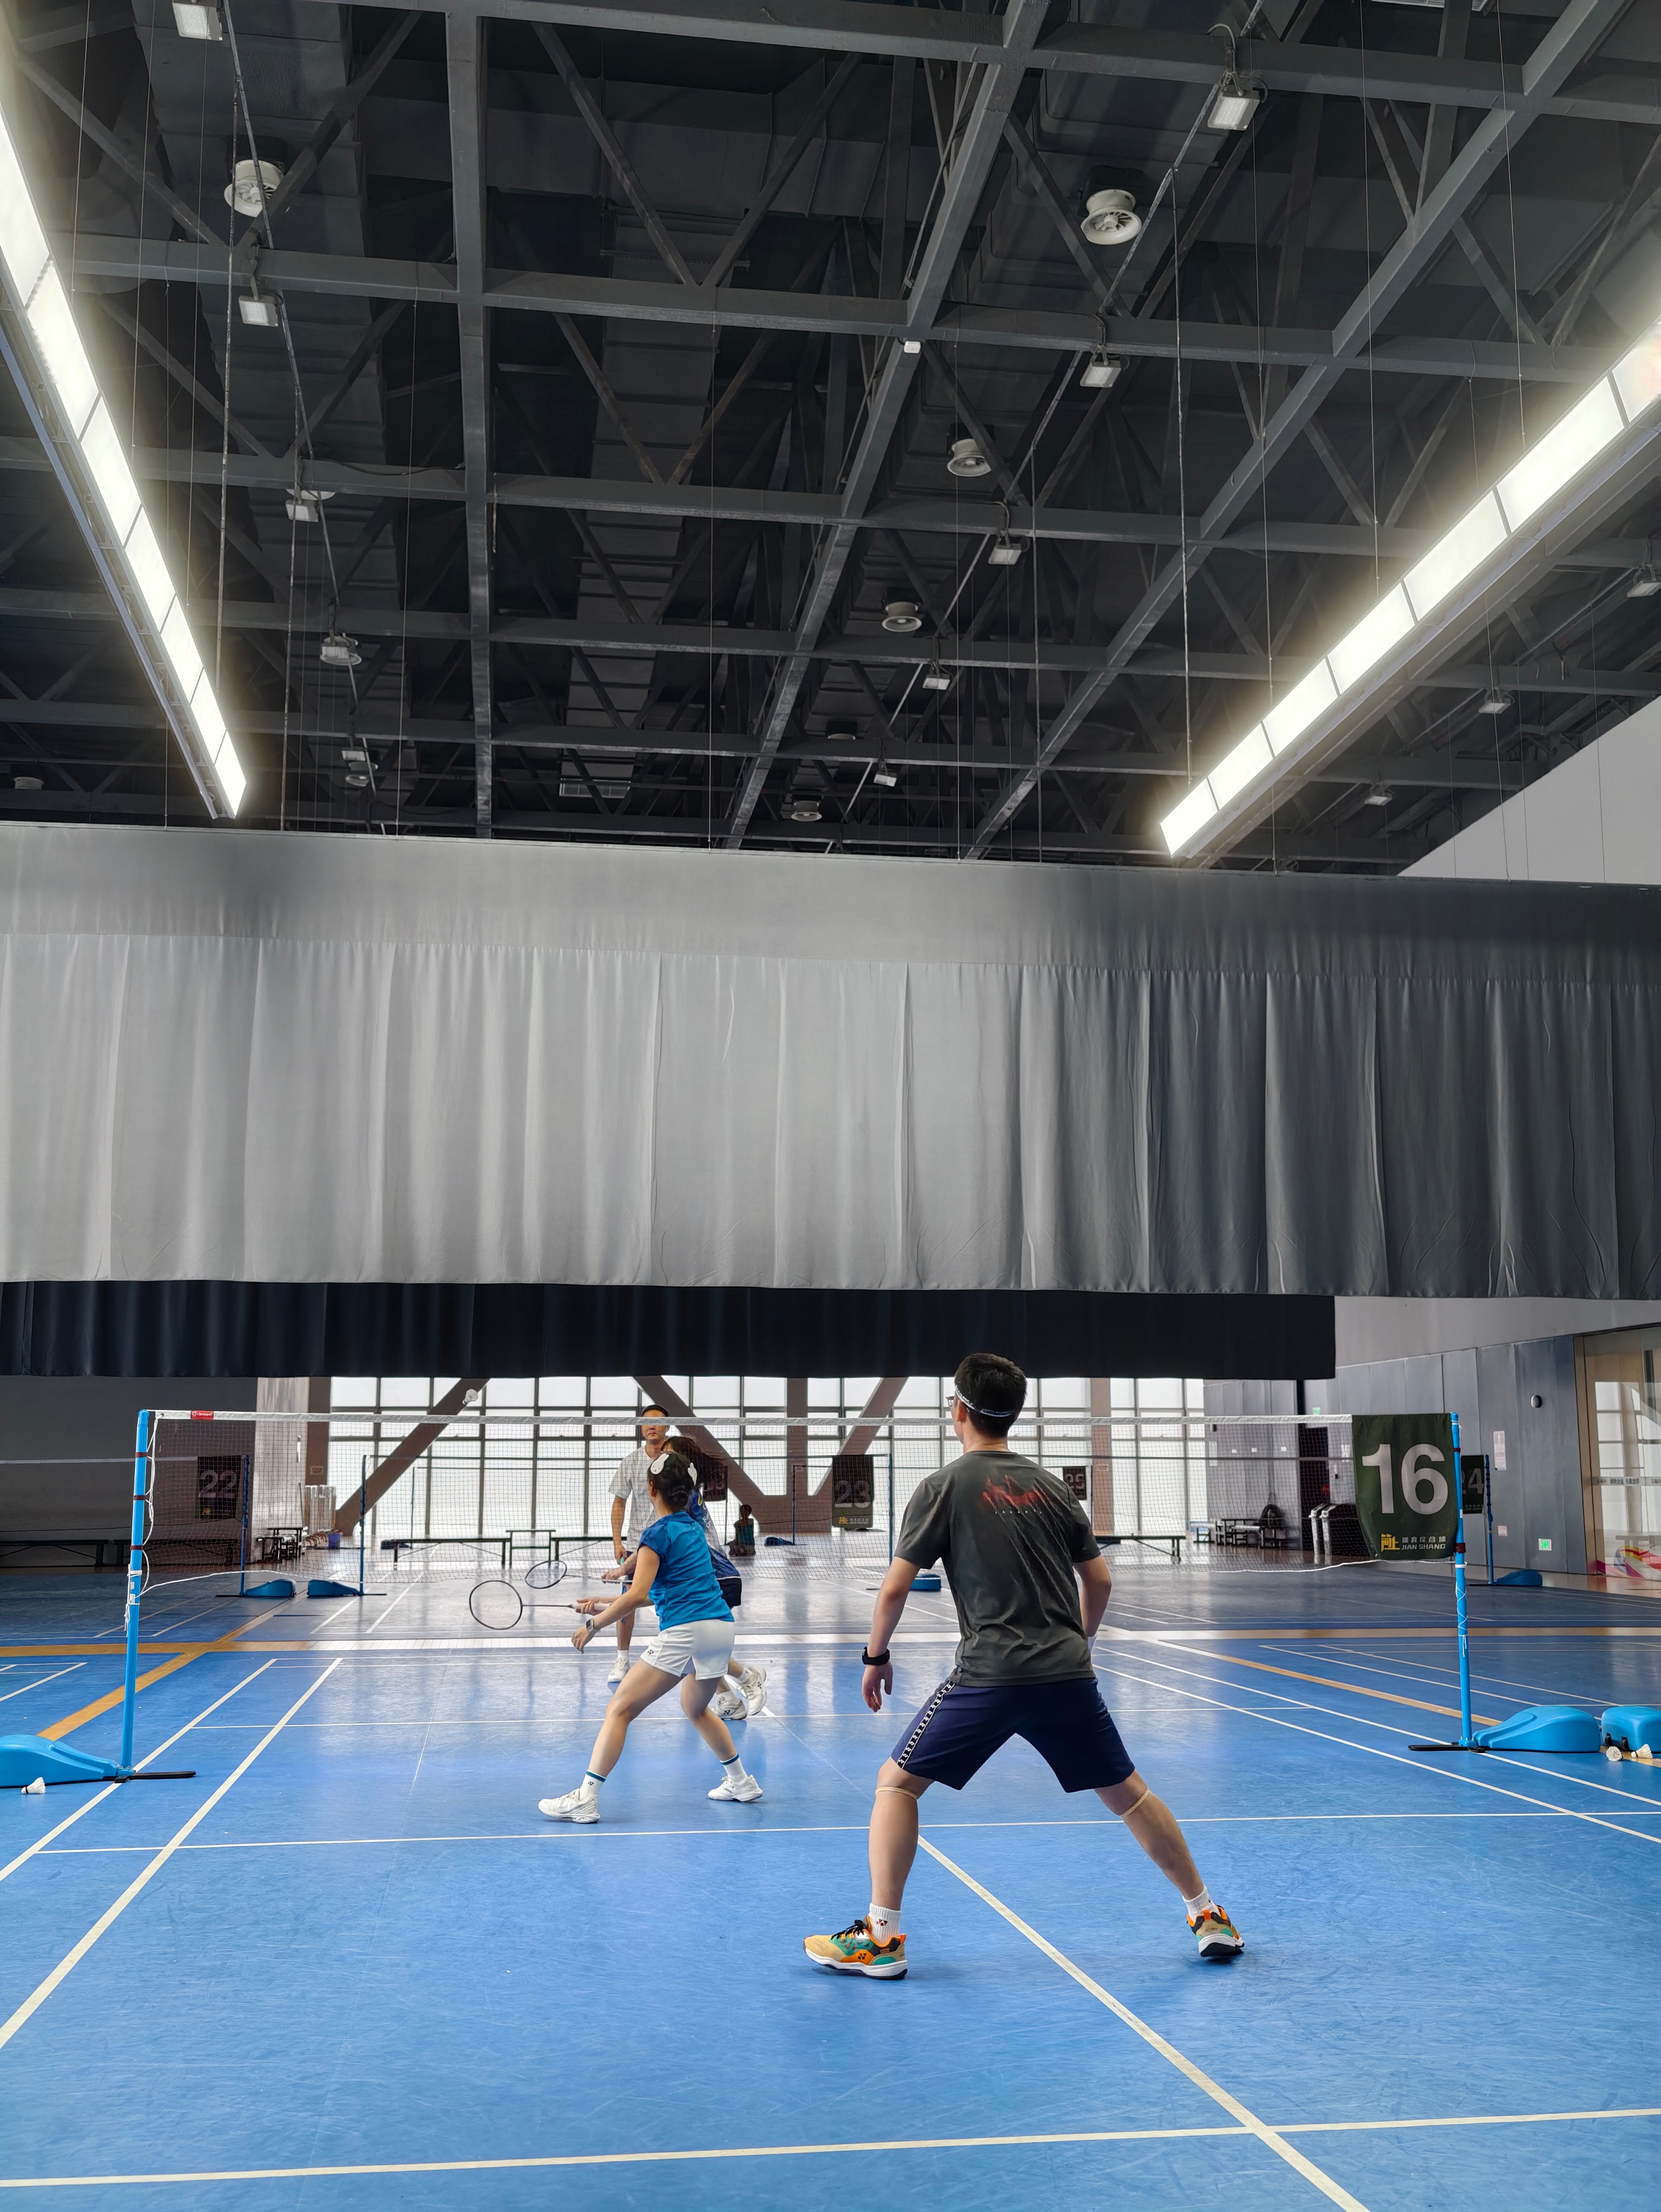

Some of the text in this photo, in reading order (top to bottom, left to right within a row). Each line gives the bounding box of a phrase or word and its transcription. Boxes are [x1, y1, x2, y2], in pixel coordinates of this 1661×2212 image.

[198, 1470, 237, 1497] 22
[1362, 1444, 1448, 1514] 16
[834, 1481, 871, 1508] 23
